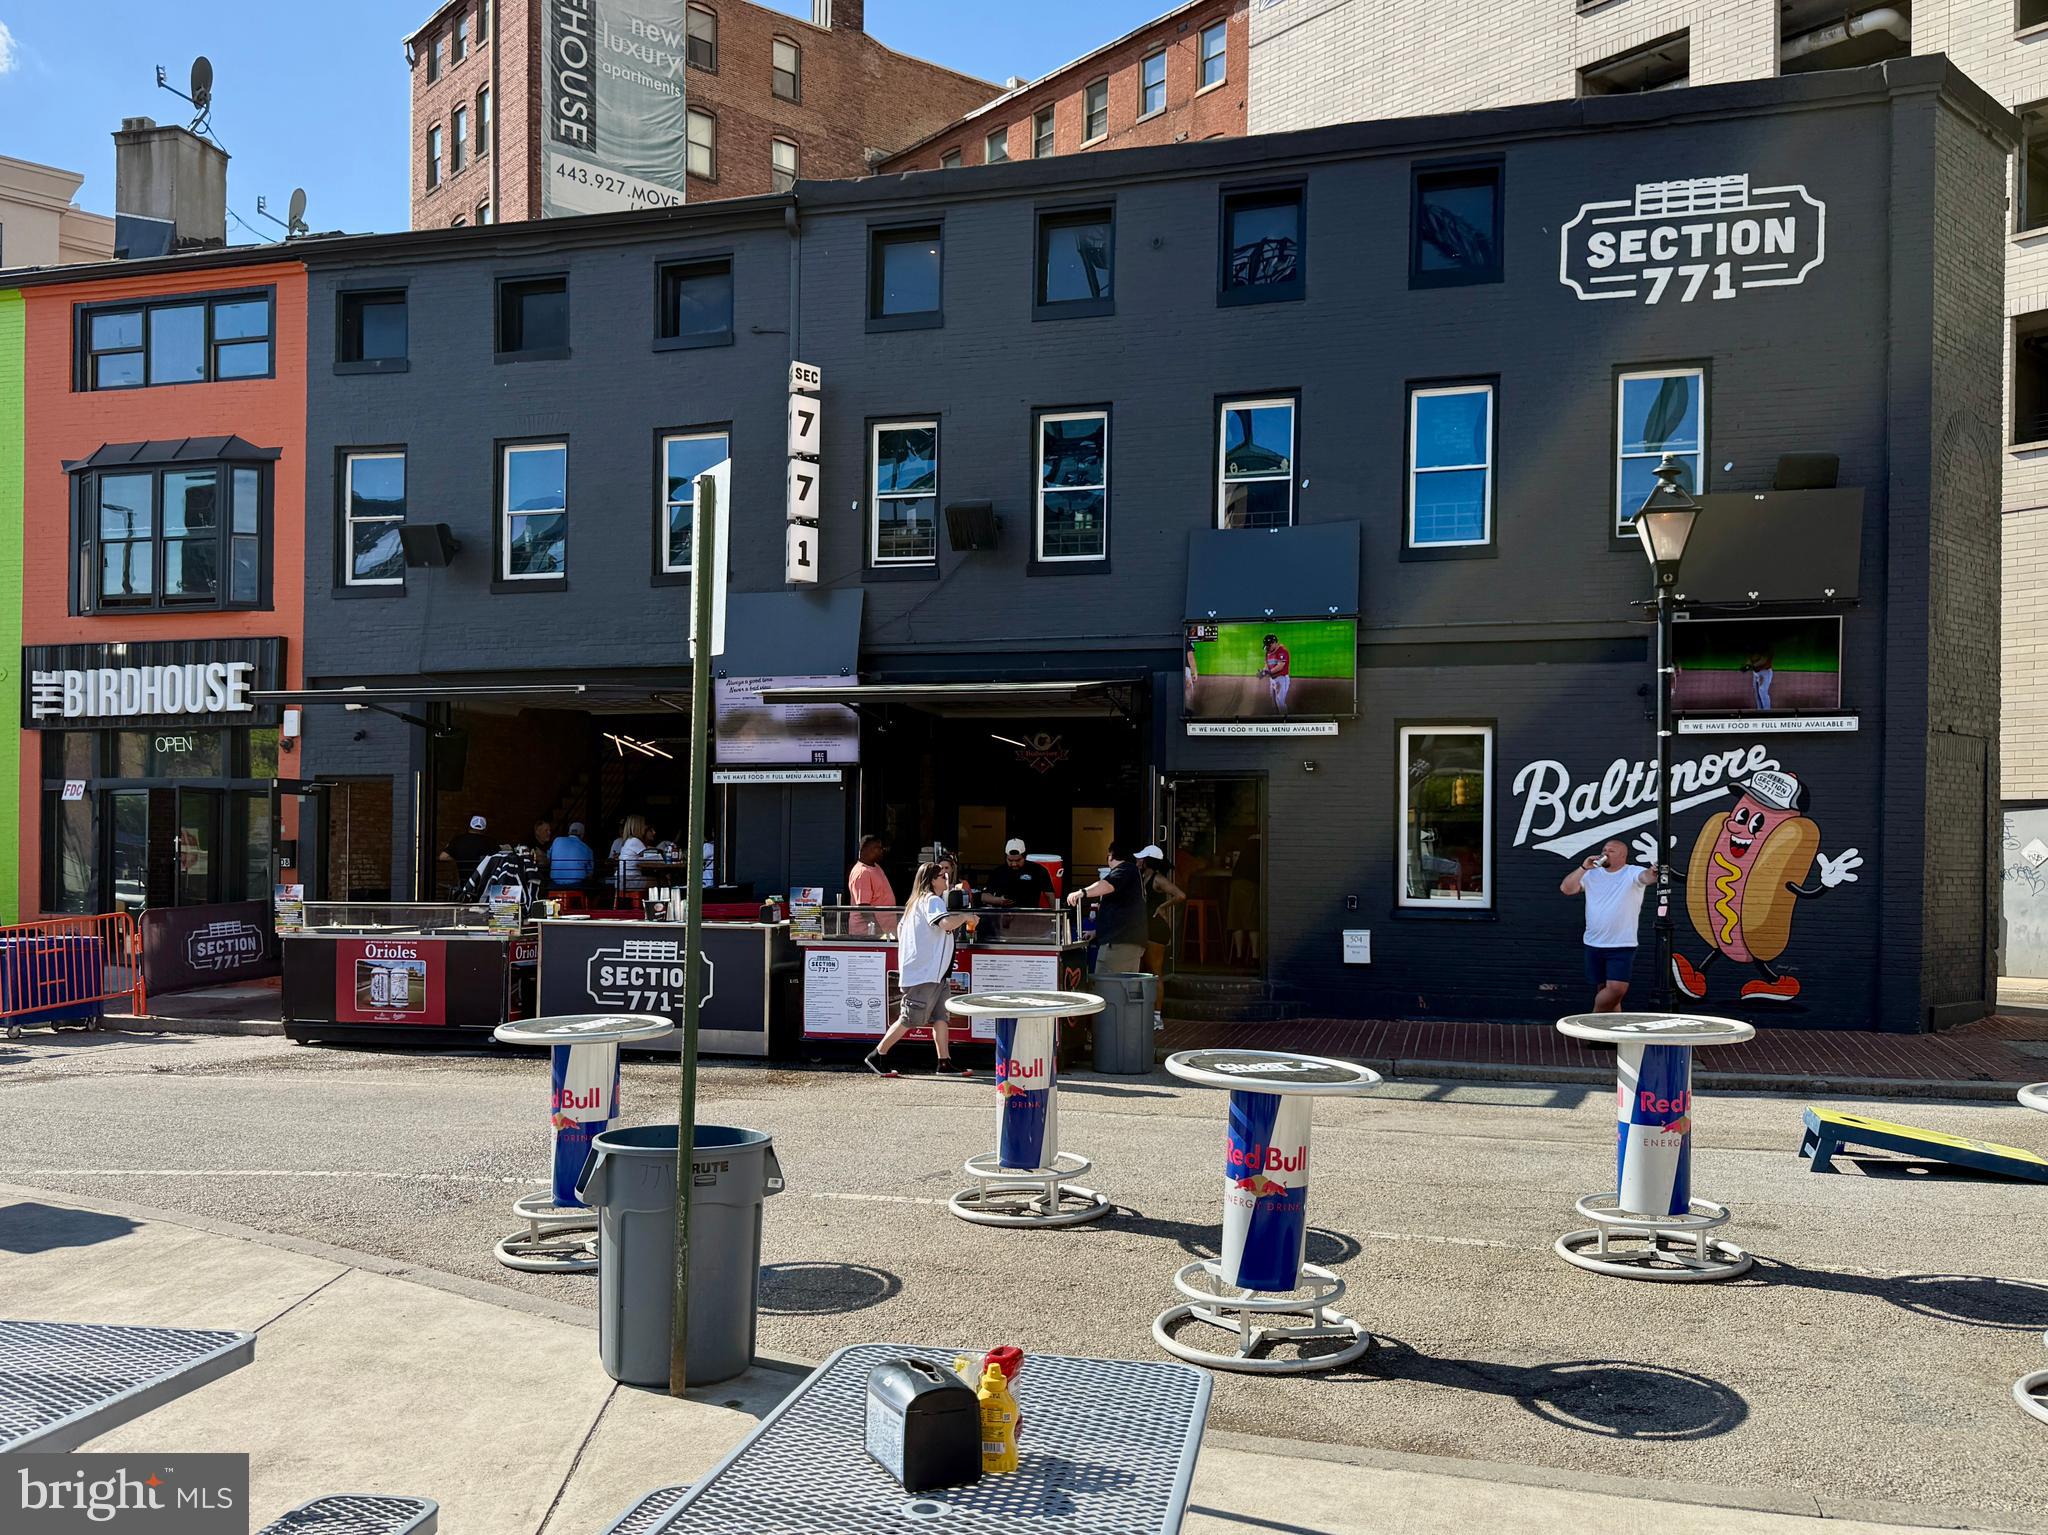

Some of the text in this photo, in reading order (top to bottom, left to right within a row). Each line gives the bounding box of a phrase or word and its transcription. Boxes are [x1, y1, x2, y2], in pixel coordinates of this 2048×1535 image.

[631, 18, 681, 48] new
[603, 22, 681, 78] luxury
[603, 61, 681, 98] apartments
[1586, 216, 1796, 269] SECTION
[1642, 262, 1736, 305] 771
[795, 367, 818, 384] SEC
[32, 670, 64, 720] THE
[63, 662, 255, 718] BIRDHOUSE
[1805, 720, 1844, 728] AVAILABLE
[155, 736, 193, 752] OPEN
[64, 783, 84, 798] FDC
[1512, 744, 1780, 847] Baltimore
[1758, 775, 1787, 795] SECTION
[1762, 785, 1774, 795] 771
[197, 937, 256, 957] SECTION
[365, 943, 417, 959] Orioles
[515, 945, 537, 960] Oriol
[213, 954, 240, 970] 771
[600, 966, 684, 987] SECTIO
[627, 990, 672, 1012] 771
[1009, 1058, 1043, 1078] Bull
[562, 1087, 600, 1109] Bull
[1640, 1090, 1683, 1114] Red
[1227, 1137, 1307, 1172] Red Bull
[692, 1161, 729, 1174] RUTE
